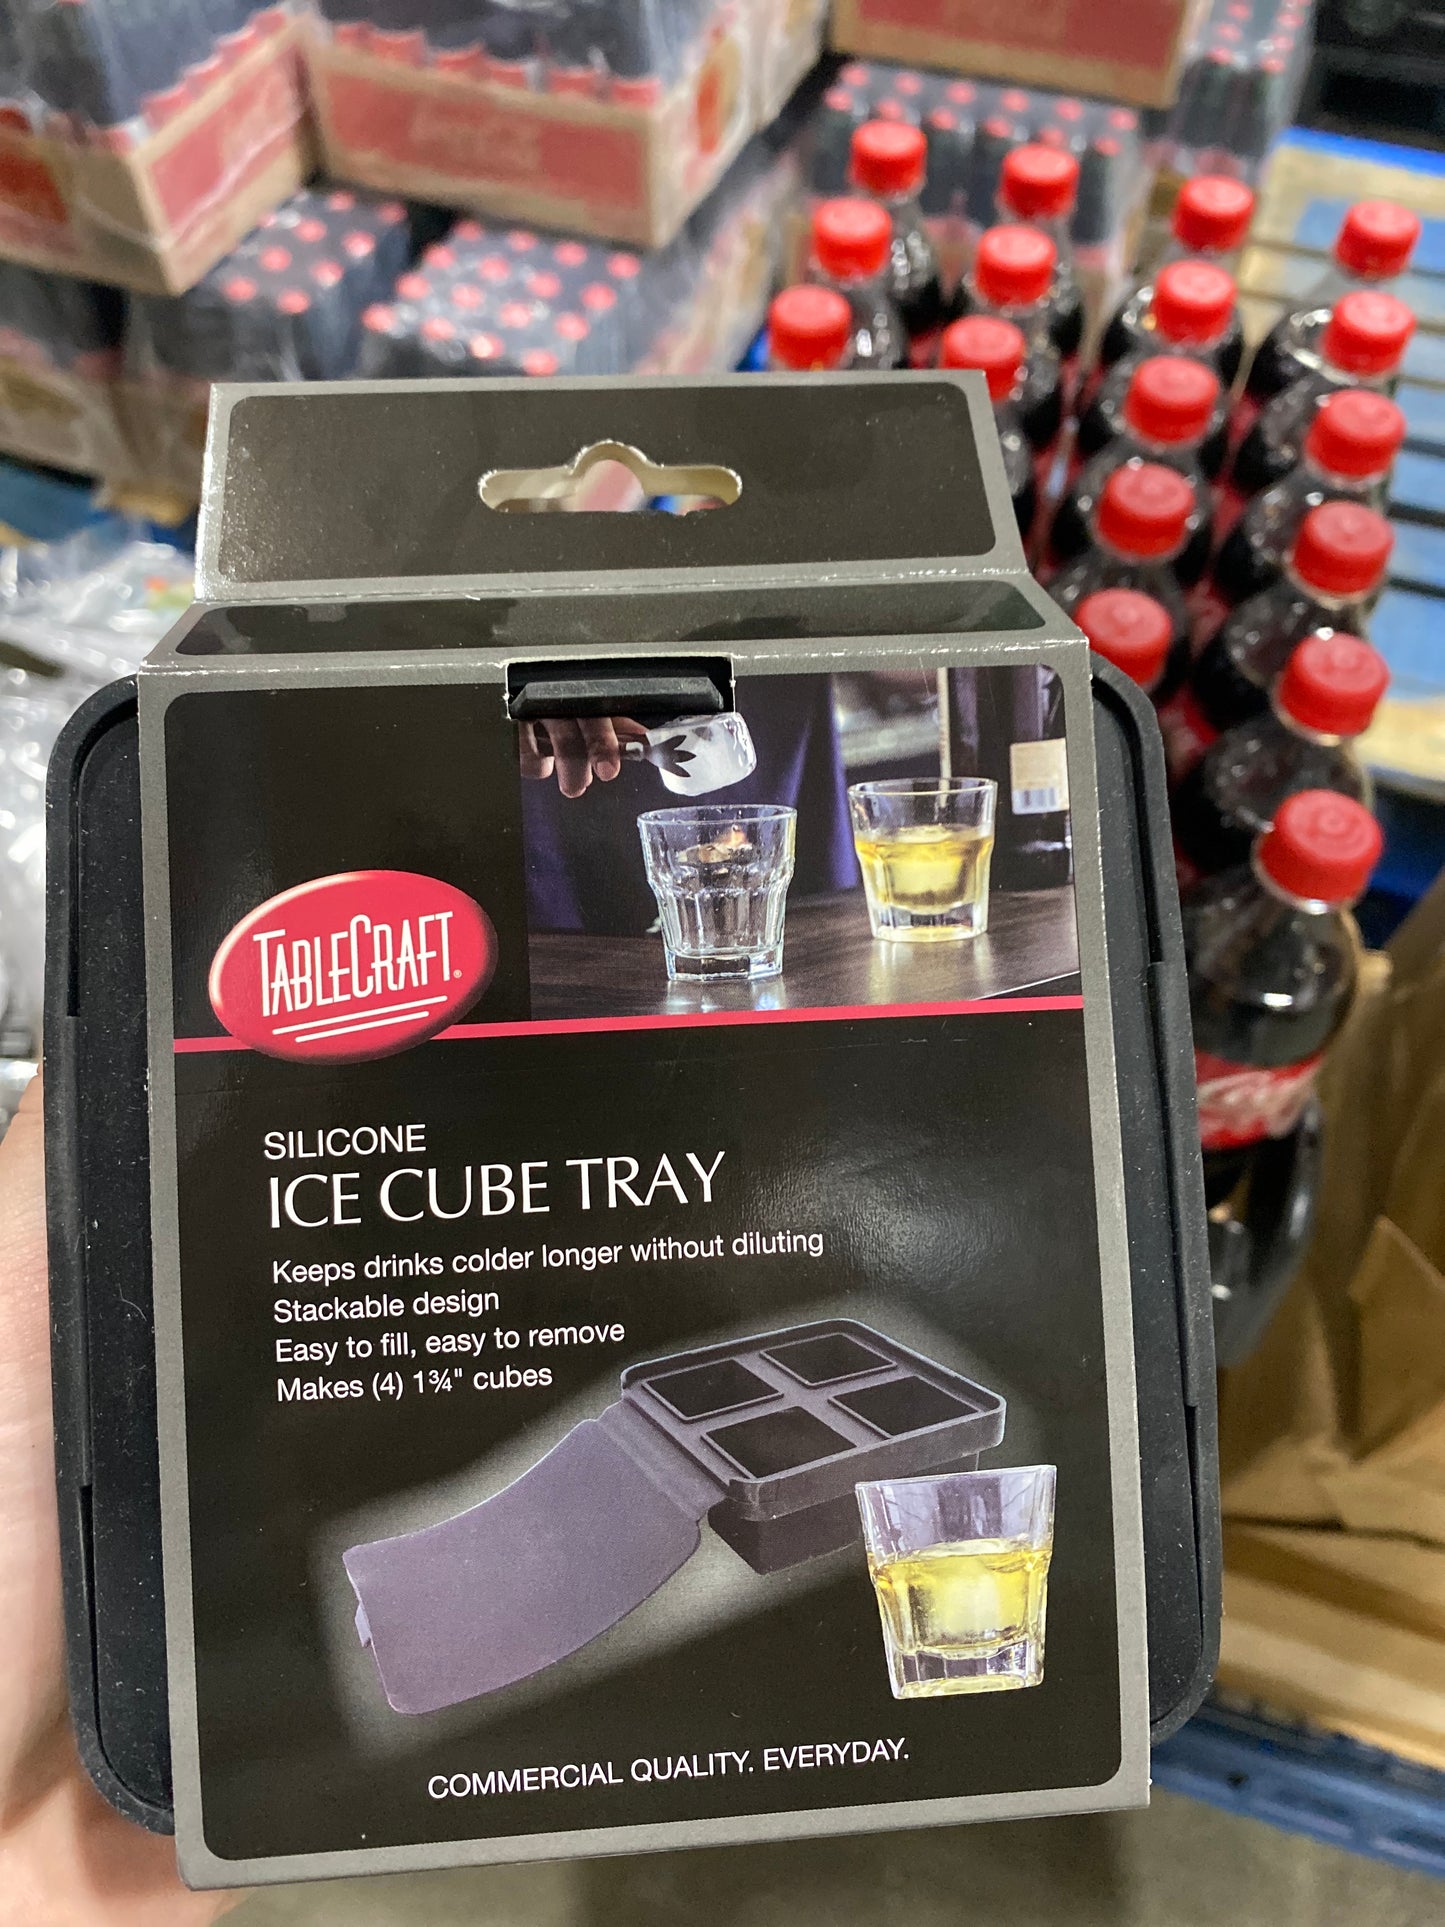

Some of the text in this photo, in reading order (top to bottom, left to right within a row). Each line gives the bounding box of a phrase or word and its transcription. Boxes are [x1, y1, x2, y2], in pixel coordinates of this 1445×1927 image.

[264, 1124, 427, 1160] SILICONE
[270, 1150, 726, 1228] ICE CUBE TRAY
[273, 1230, 824, 1286] Keeps drinks colder longer without diluting
[273, 1289, 499, 1323] Stackable design
[275, 1323, 625, 1365] Easy to fill, easy to remove
[277, 1376, 364, 1401] Makes
[372, 1371, 404, 1401] (4)
[473, 1364, 553, 1390] cubes
[427, 1737, 910, 1799] COMMERCIAL QUALITY. EVERYDAY.
